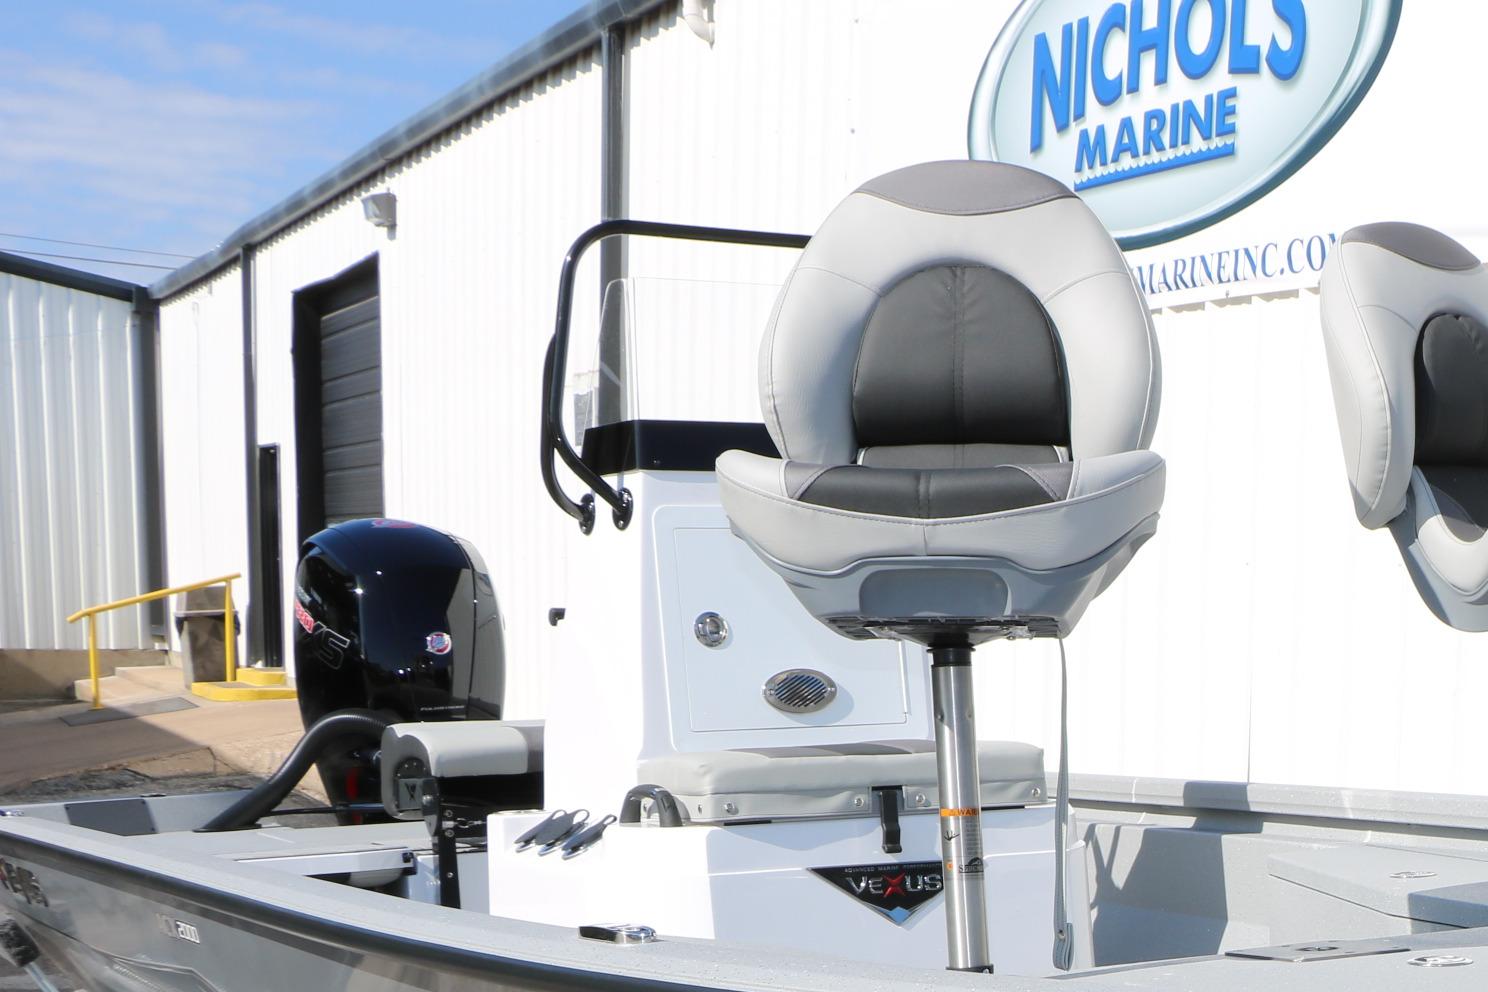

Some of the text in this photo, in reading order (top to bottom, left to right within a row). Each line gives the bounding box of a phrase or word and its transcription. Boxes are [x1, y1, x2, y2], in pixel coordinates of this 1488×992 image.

[1030, 0, 1307, 153] NICHOLS
[1074, 86, 1238, 173] MARINE
[1132, 232, 1338, 295] MARINEINC.CO
[845, 873, 943, 898] VEXUS
